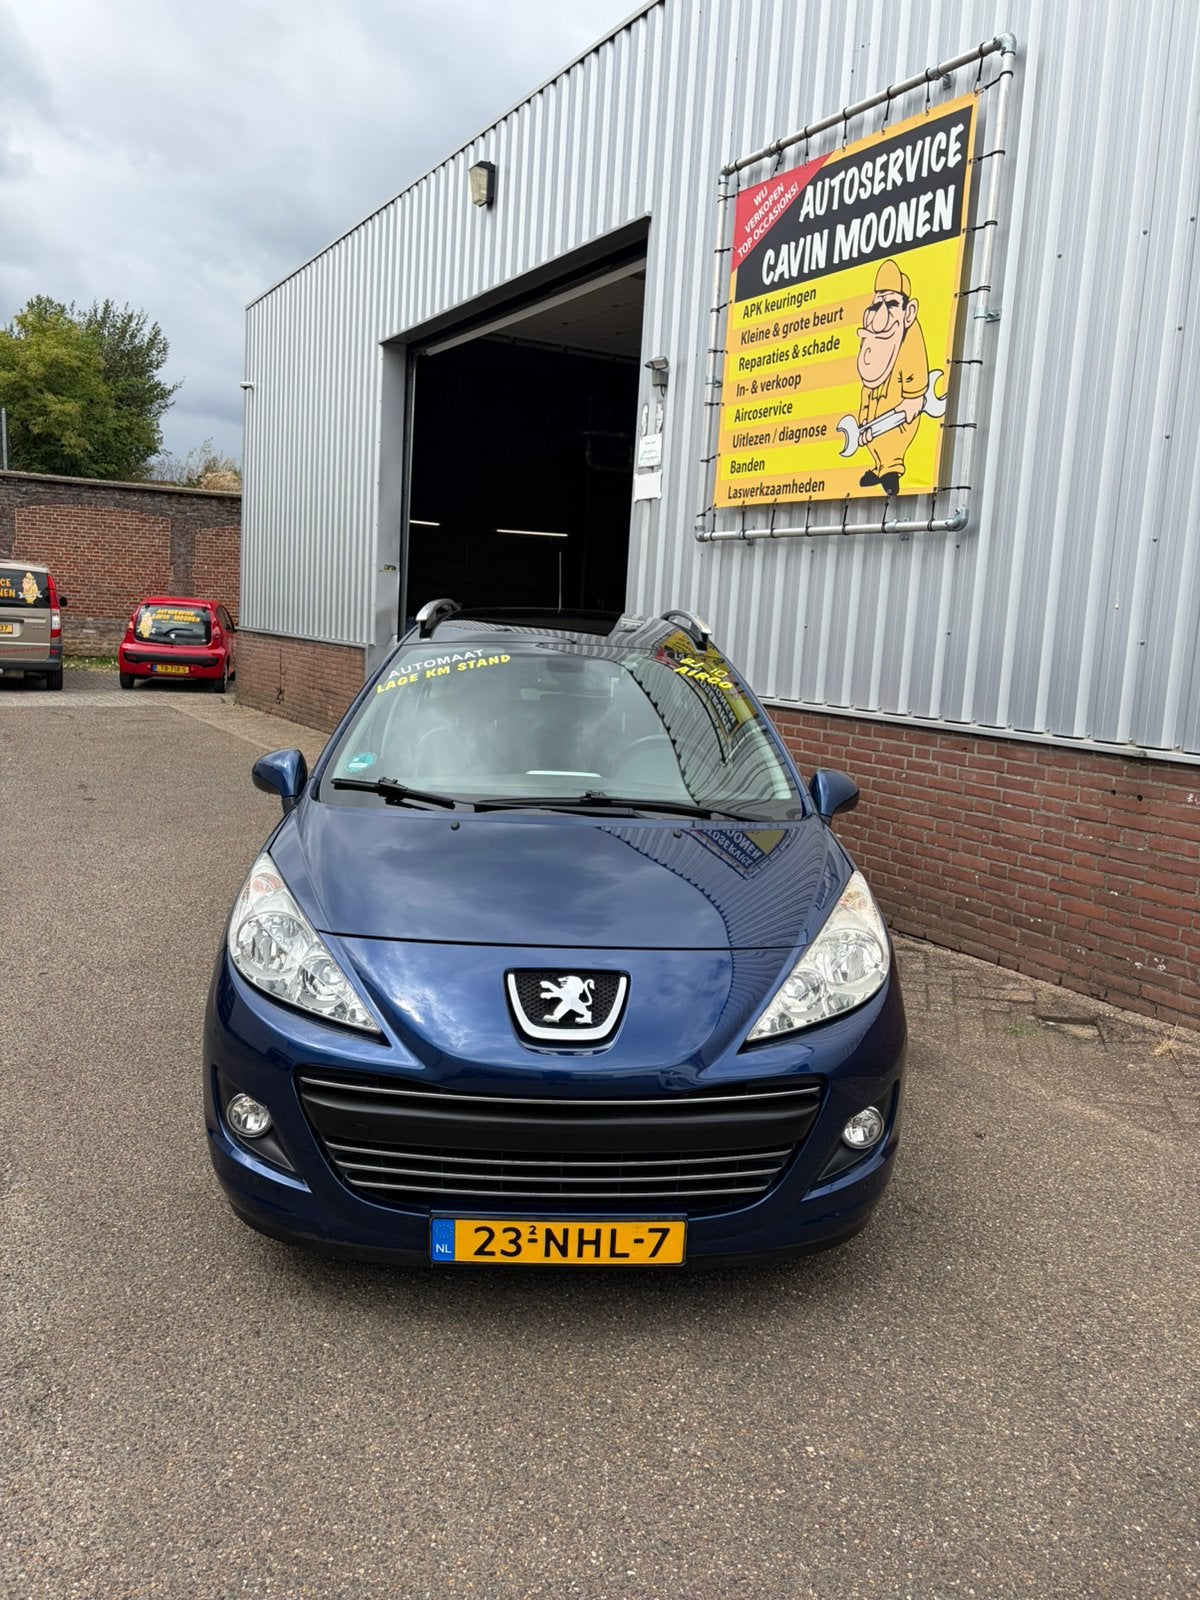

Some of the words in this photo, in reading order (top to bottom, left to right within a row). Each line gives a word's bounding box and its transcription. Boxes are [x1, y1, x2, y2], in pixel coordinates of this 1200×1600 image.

[799, 122, 965, 223] AUTOSERVICE
[737, 236, 753, 258] TOP
[753, 181, 799, 240] OCCASIONS!
[744, 182, 785, 233] VERKOPEN
[761, 228, 830, 286] CAVIN
[832, 184, 956, 265] MOONEN
[742, 300, 762, 320] APK
[764, 287, 817, 313] keuringen
[740, 325, 770, 346] Kleine
[772, 323, 780, 338] &
[782, 318, 810, 339] grote
[812, 306, 844, 327] beurt
[738, 346, 790, 372] Reparaties
[792, 344, 800, 360] &
[801, 335, 841, 357] schade
[736, 382, 749, 397] In-
[750, 379, 759, 394] &
[760, 372, 801, 394] verkoop
[734, 401, 793, 423] Aircoservice
[732, 430, 770, 449] Uitlezen
[772, 428, 778, 443] /
[778, 423, 827, 444] diagnose
[730, 457, 765, 474] Banden
[728, 478, 825, 499] Laswerkzaamheden
[376, 673, 418, 694] LAGE
[425, 665, 451, 678] KM
[457, 654, 511, 671] STAND
[388, 649, 484, 679] AUTOMAAT
[673, 666, 733, 690] AIRCO
[435, 1243, 452, 1254] NL
